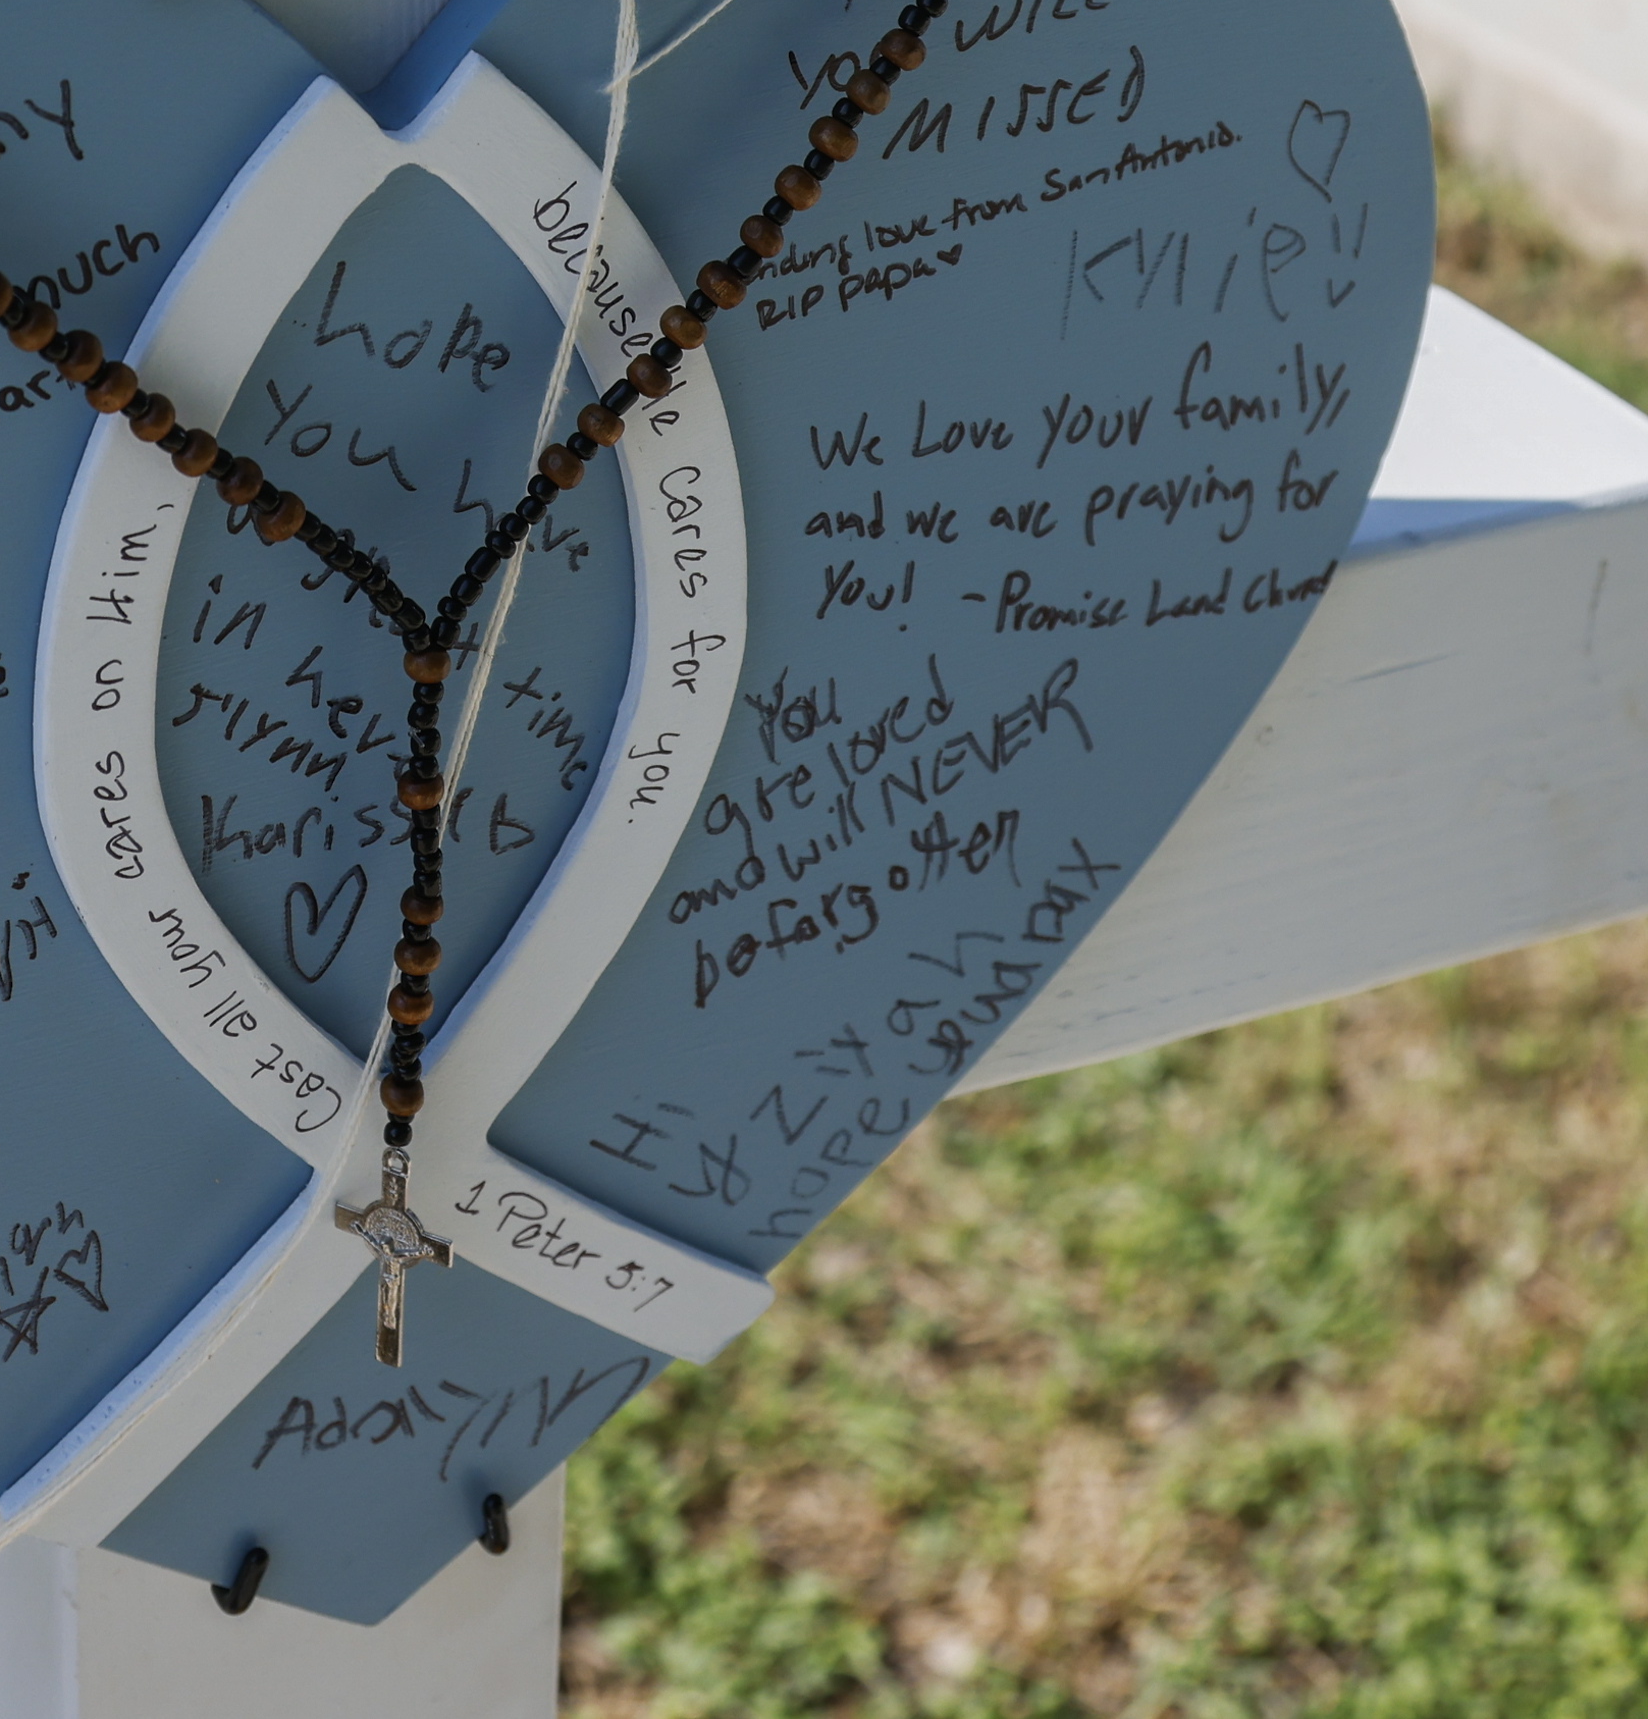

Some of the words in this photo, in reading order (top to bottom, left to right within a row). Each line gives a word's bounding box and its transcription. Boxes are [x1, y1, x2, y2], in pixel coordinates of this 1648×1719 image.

[881, 44, 1147, 160] MISSED
[863, 213, 938, 252] love
[940, 190, 1030, 232] from
[755, 283, 825, 331] RIP
[809, 411, 885, 470] We
[910, 398, 1015, 458] Love
[452, 456, 590, 574] hve
[803, 488, 885, 541] and
[906, 500, 959, 544] we
[988, 497, 1058, 540] are
[1084, 463, 1253, 546] praying
[1279, 448, 1340, 513] for
[192, 573, 267, 650] in
[1144, 566, 1232, 629] Land
[89, 657, 125, 713] on
[670, 629, 727, 695] for
[826, 653, 954, 786] loved
[627, 731, 681, 825] you.
[776, 780, 866, 882] will
[880, 657, 1094, 827] NEVER
[92, 749, 146, 882] cares
[146, 906, 227, 991] your
[201, 989, 259, 1039] all
[250, 1041, 344, 1134] Cast
[497, 1190, 602, 1270] Peter
[604, 1259, 676, 1313] 5:7
